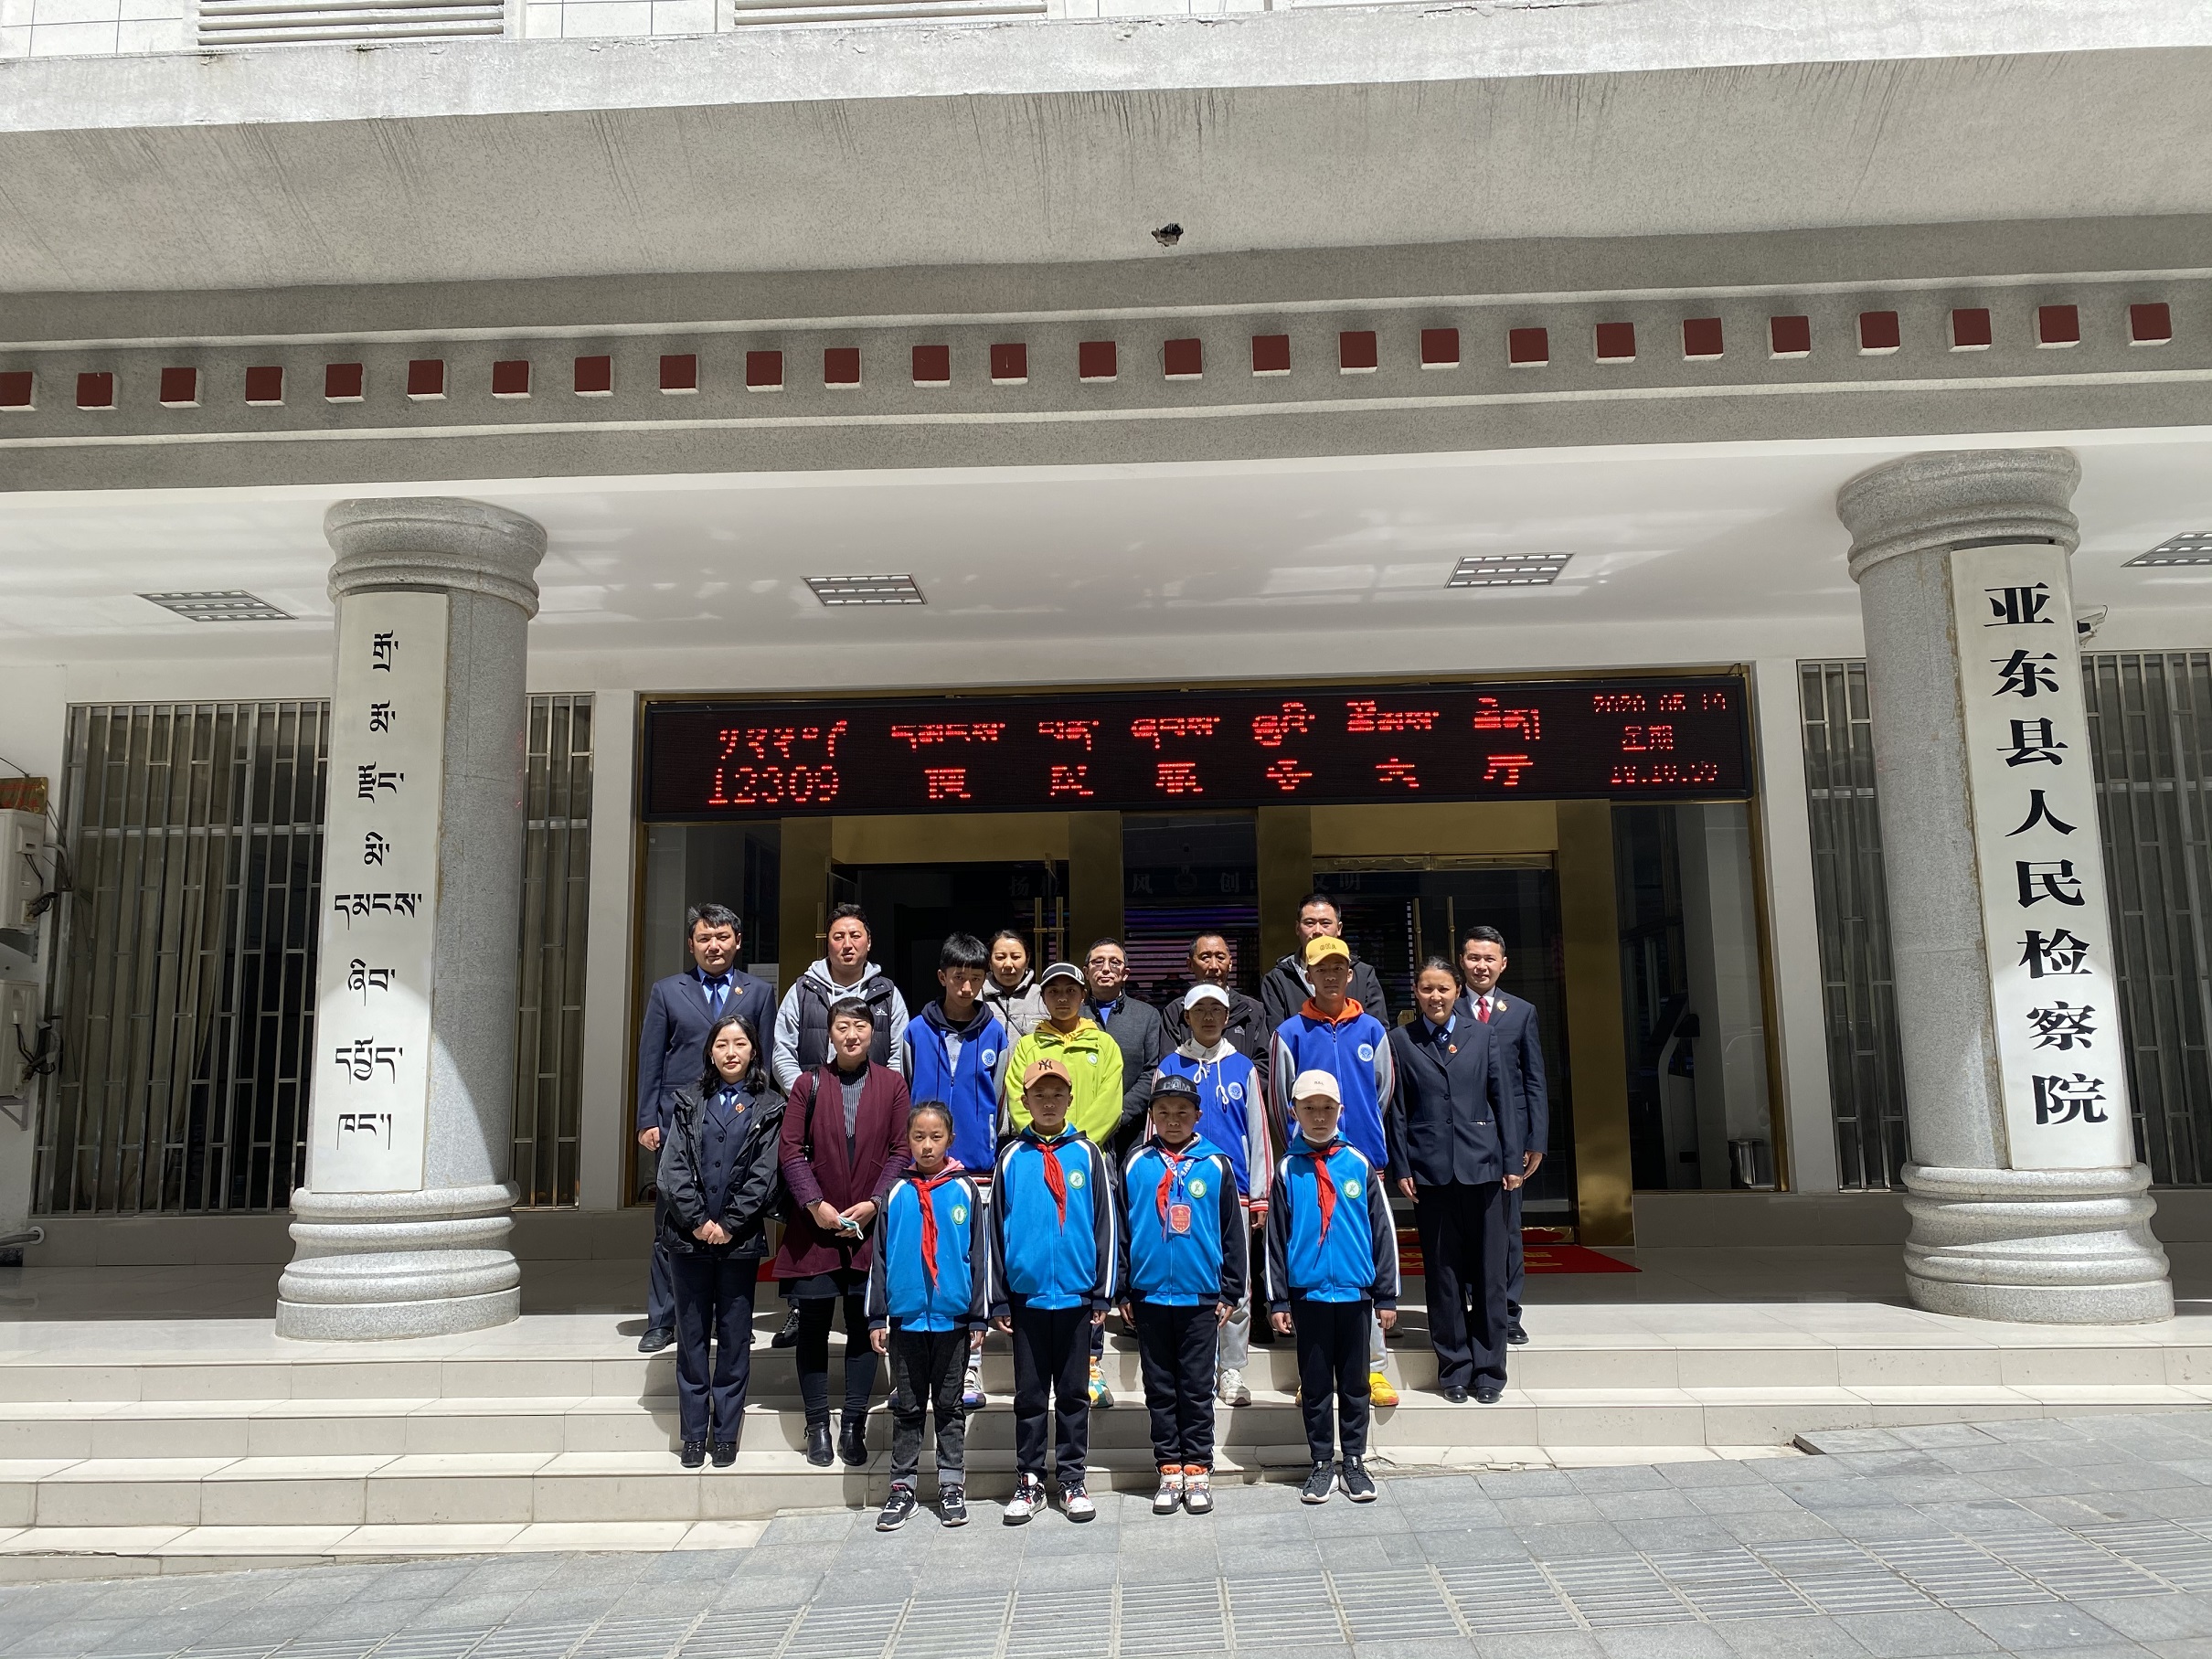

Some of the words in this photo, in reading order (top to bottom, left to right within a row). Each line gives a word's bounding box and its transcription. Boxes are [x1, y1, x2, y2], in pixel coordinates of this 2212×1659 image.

[708, 764, 839, 803] 12309
[1983, 582, 2109, 1125] 亚东县人民检察院
[1038, 1059, 1053, 1070] NY
